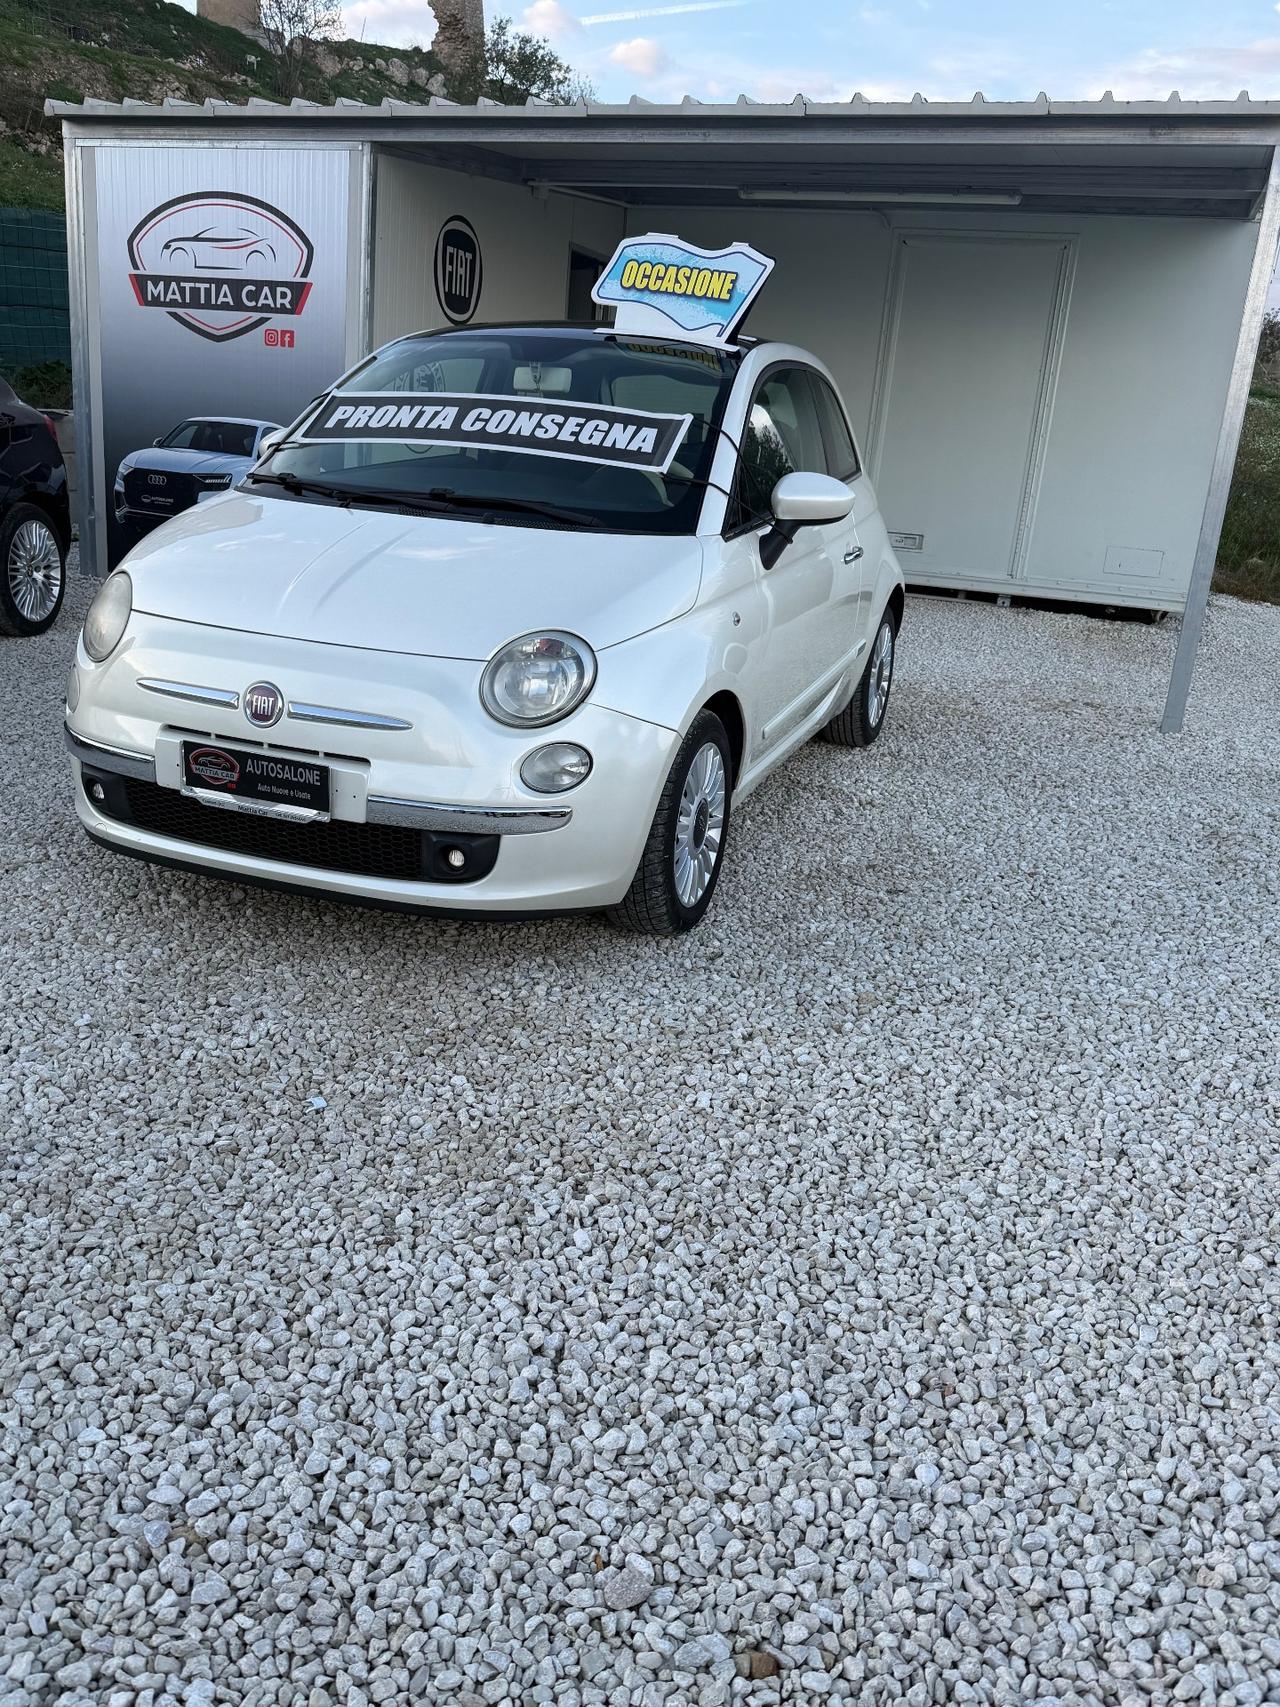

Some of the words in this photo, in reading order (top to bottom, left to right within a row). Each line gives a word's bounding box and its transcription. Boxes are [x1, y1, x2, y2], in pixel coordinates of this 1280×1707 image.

[445, 245, 473, 298] FIAT
[621, 260, 736, 300] OCCASIONE
[147, 280, 234, 306] MATTIA
[241, 285, 292, 309] CAR
[324, 405, 459, 430] PRONTA
[461, 407, 657, 453] CONSEGNA
[252, 694, 275, 716] FIAT
[195, 765, 219, 777] MATTIA
[220, 771, 235, 780] CAR
[245, 758, 321, 786] AUTOSALONE
[257, 783, 271, 793] Auto
